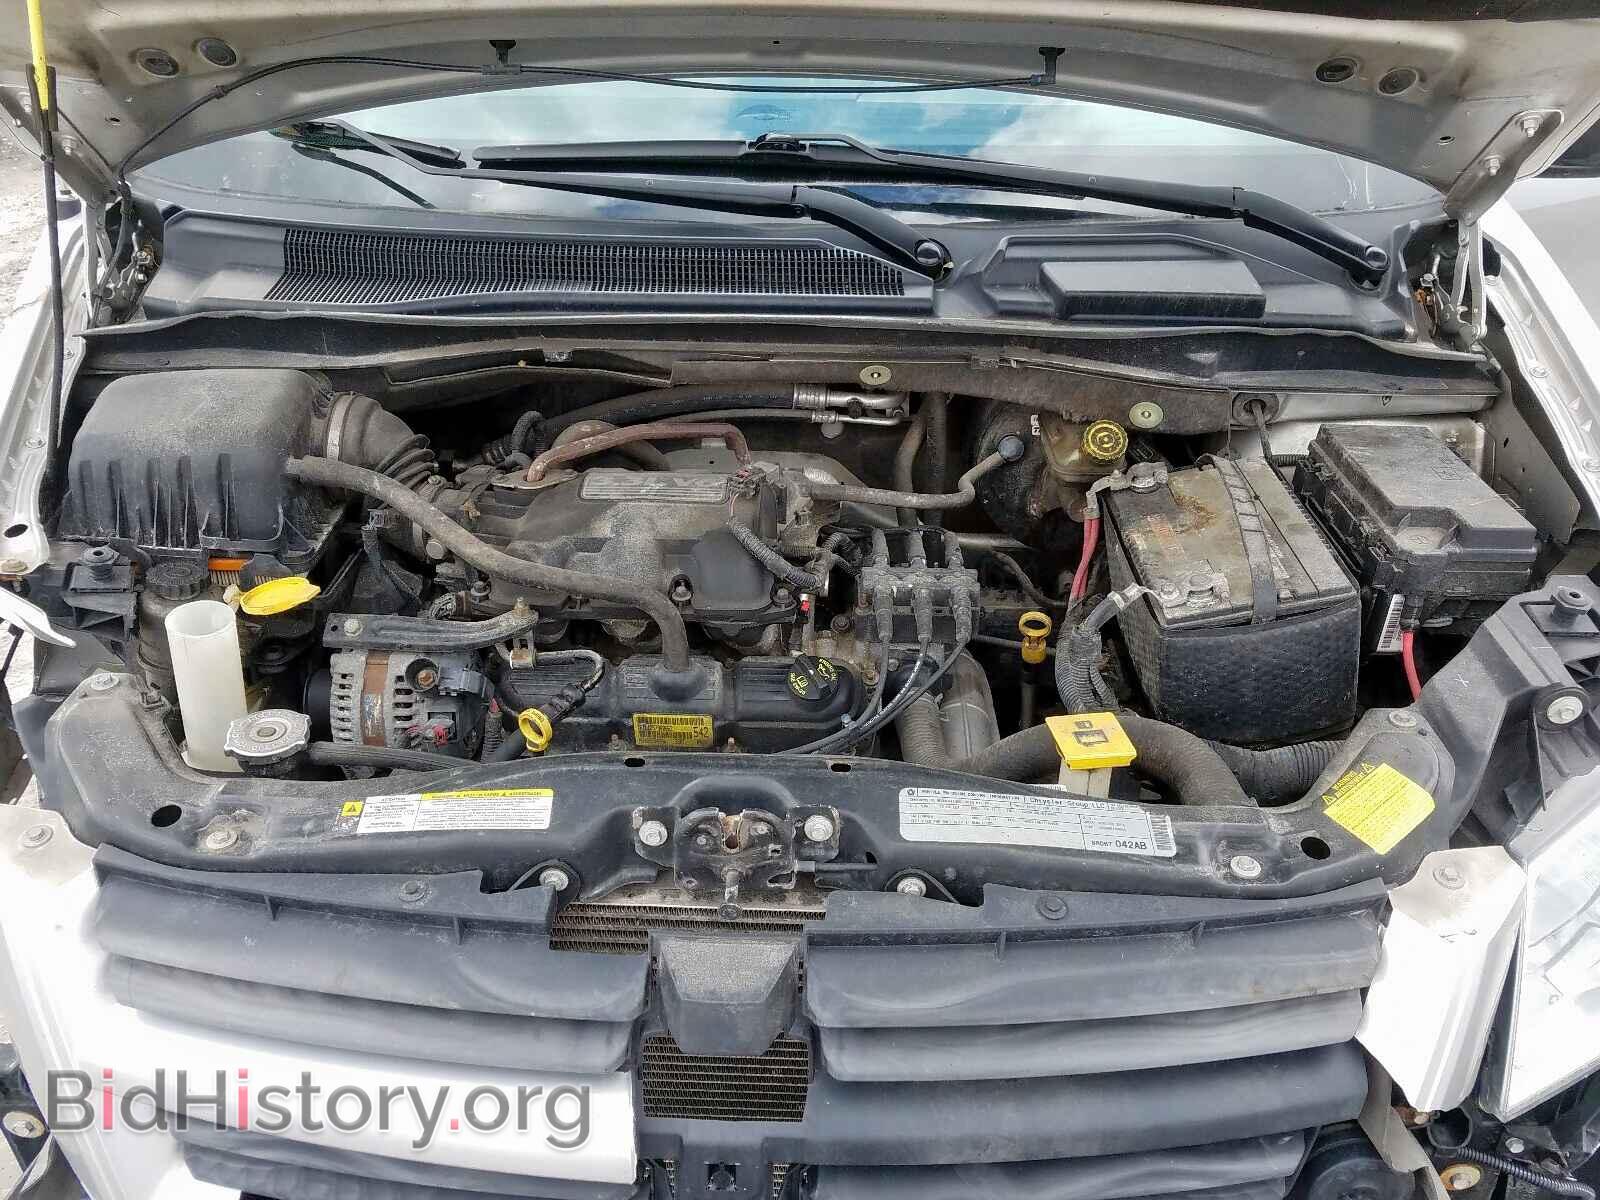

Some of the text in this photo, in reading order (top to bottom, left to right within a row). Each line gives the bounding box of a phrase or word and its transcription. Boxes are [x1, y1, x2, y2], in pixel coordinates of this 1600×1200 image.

[692, 726, 709, 738] 542
[1030, 797, 1063, 807] Chrysler
[1067, 800, 1089, 809] Group
[1090, 801, 1106, 809] LLC
